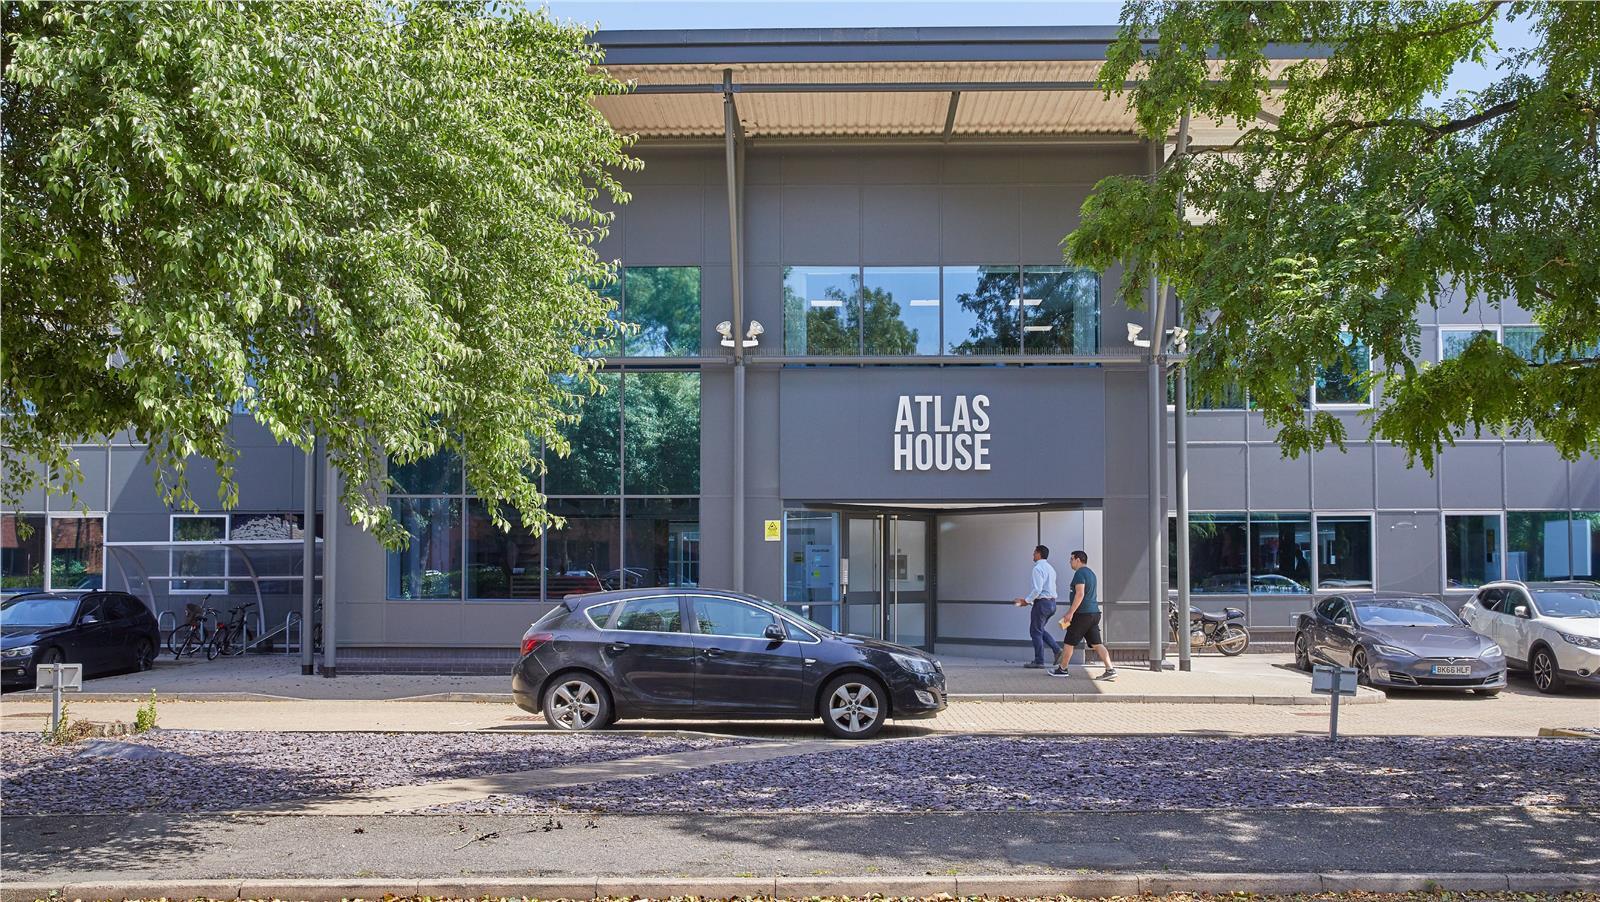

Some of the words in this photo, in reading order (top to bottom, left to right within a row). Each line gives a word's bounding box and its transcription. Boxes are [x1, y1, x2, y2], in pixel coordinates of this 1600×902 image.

[894, 394, 990, 432] ATLAS
[894, 433, 991, 471] HOUSE
[1437, 666, 1455, 674] BK66
[1457, 666, 1470, 674] HLF
